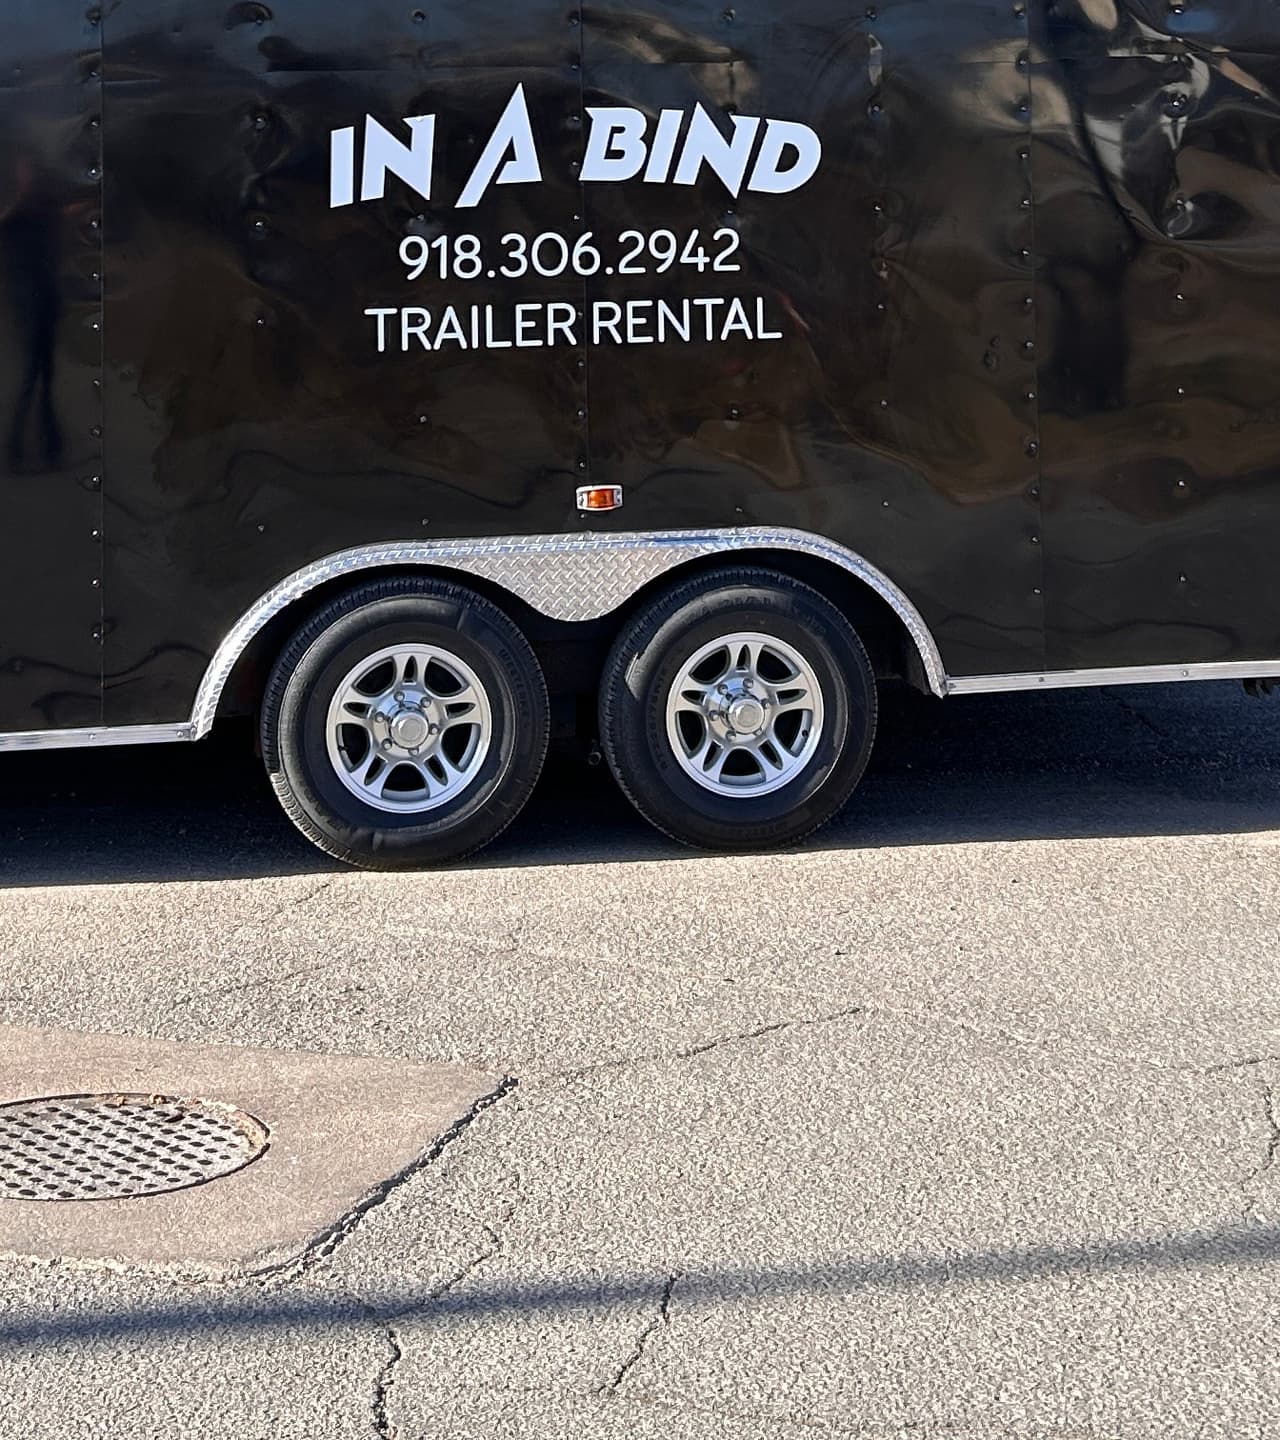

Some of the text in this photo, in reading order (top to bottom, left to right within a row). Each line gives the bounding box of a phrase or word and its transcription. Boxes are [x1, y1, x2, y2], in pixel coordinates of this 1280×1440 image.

[329, 82, 822, 209] IN A BIND
[398, 227, 741, 281] 918.306.2942
[364, 296, 783, 353] TRAILER RENTAL
